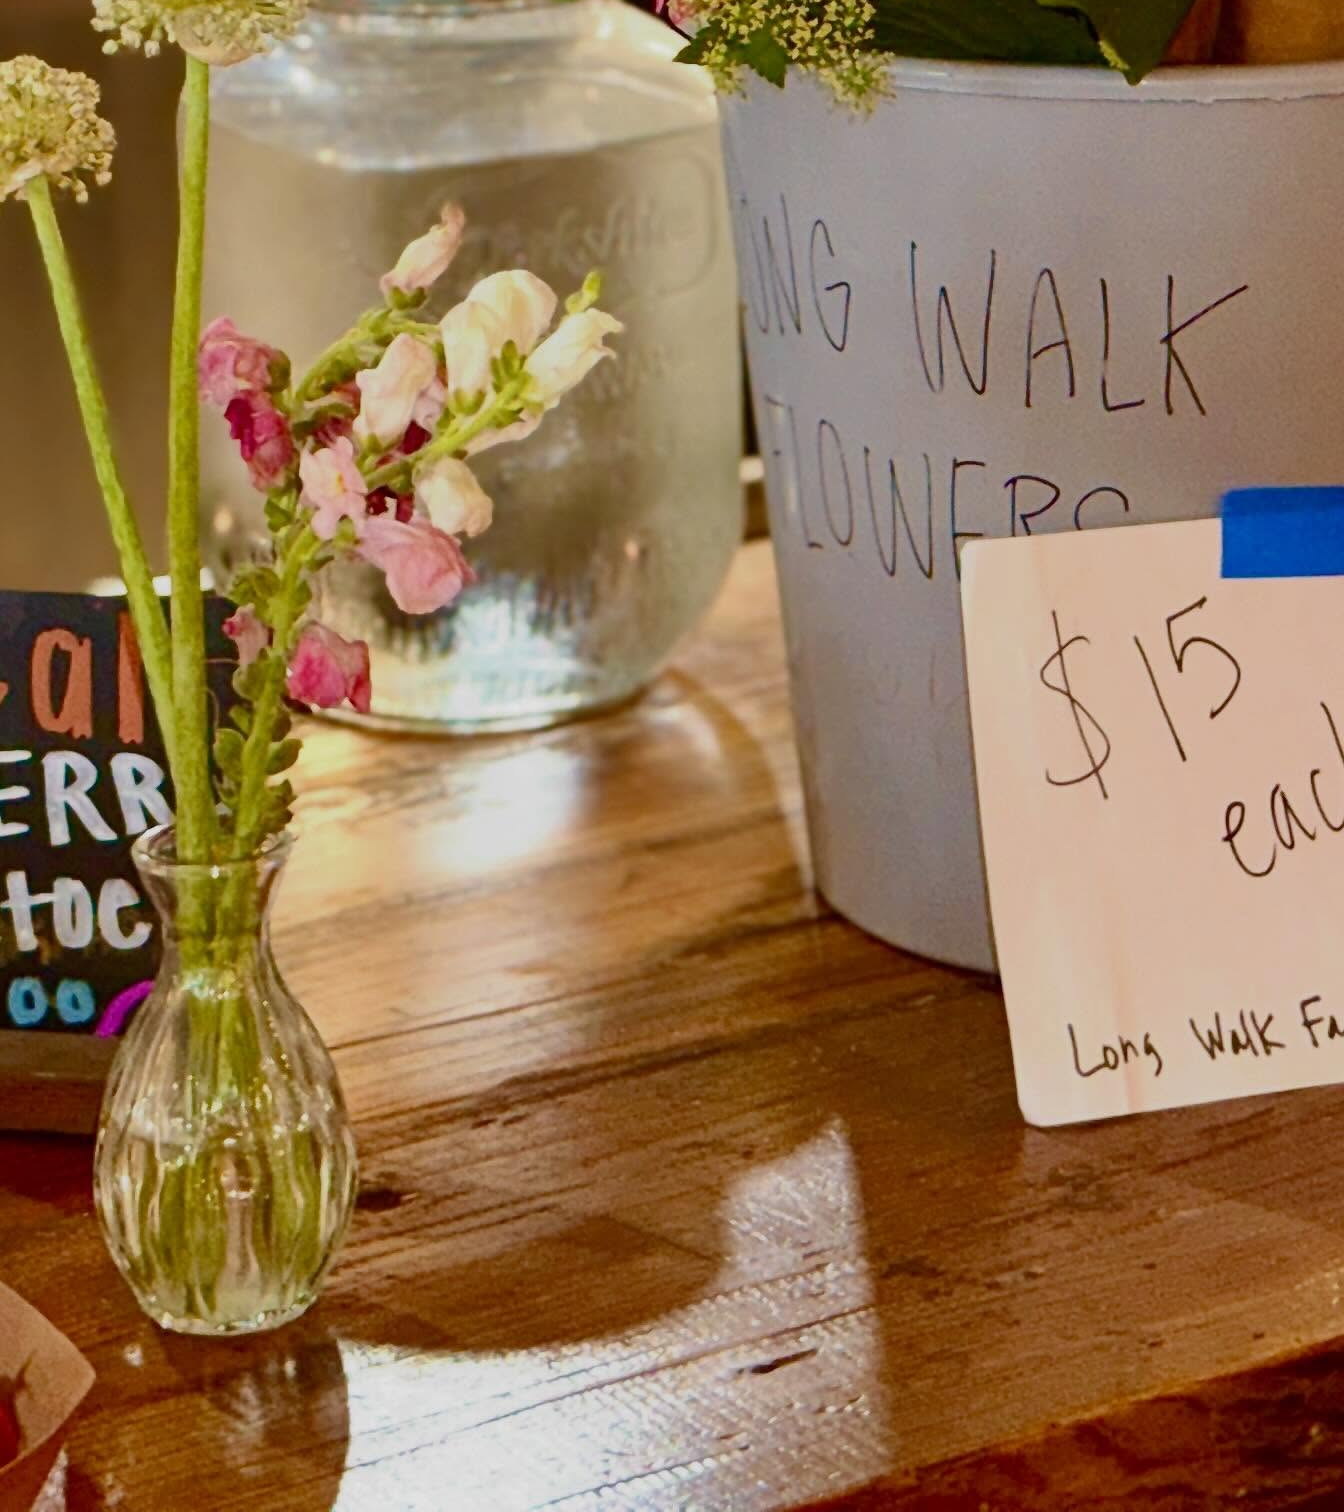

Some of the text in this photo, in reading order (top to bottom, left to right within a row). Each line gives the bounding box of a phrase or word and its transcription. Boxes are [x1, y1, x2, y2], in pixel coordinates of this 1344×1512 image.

[909, 239, 1249, 417] WALK
[1040, 596, 1241, 800] $15
[1068, 1023, 1163, 1078] Long
